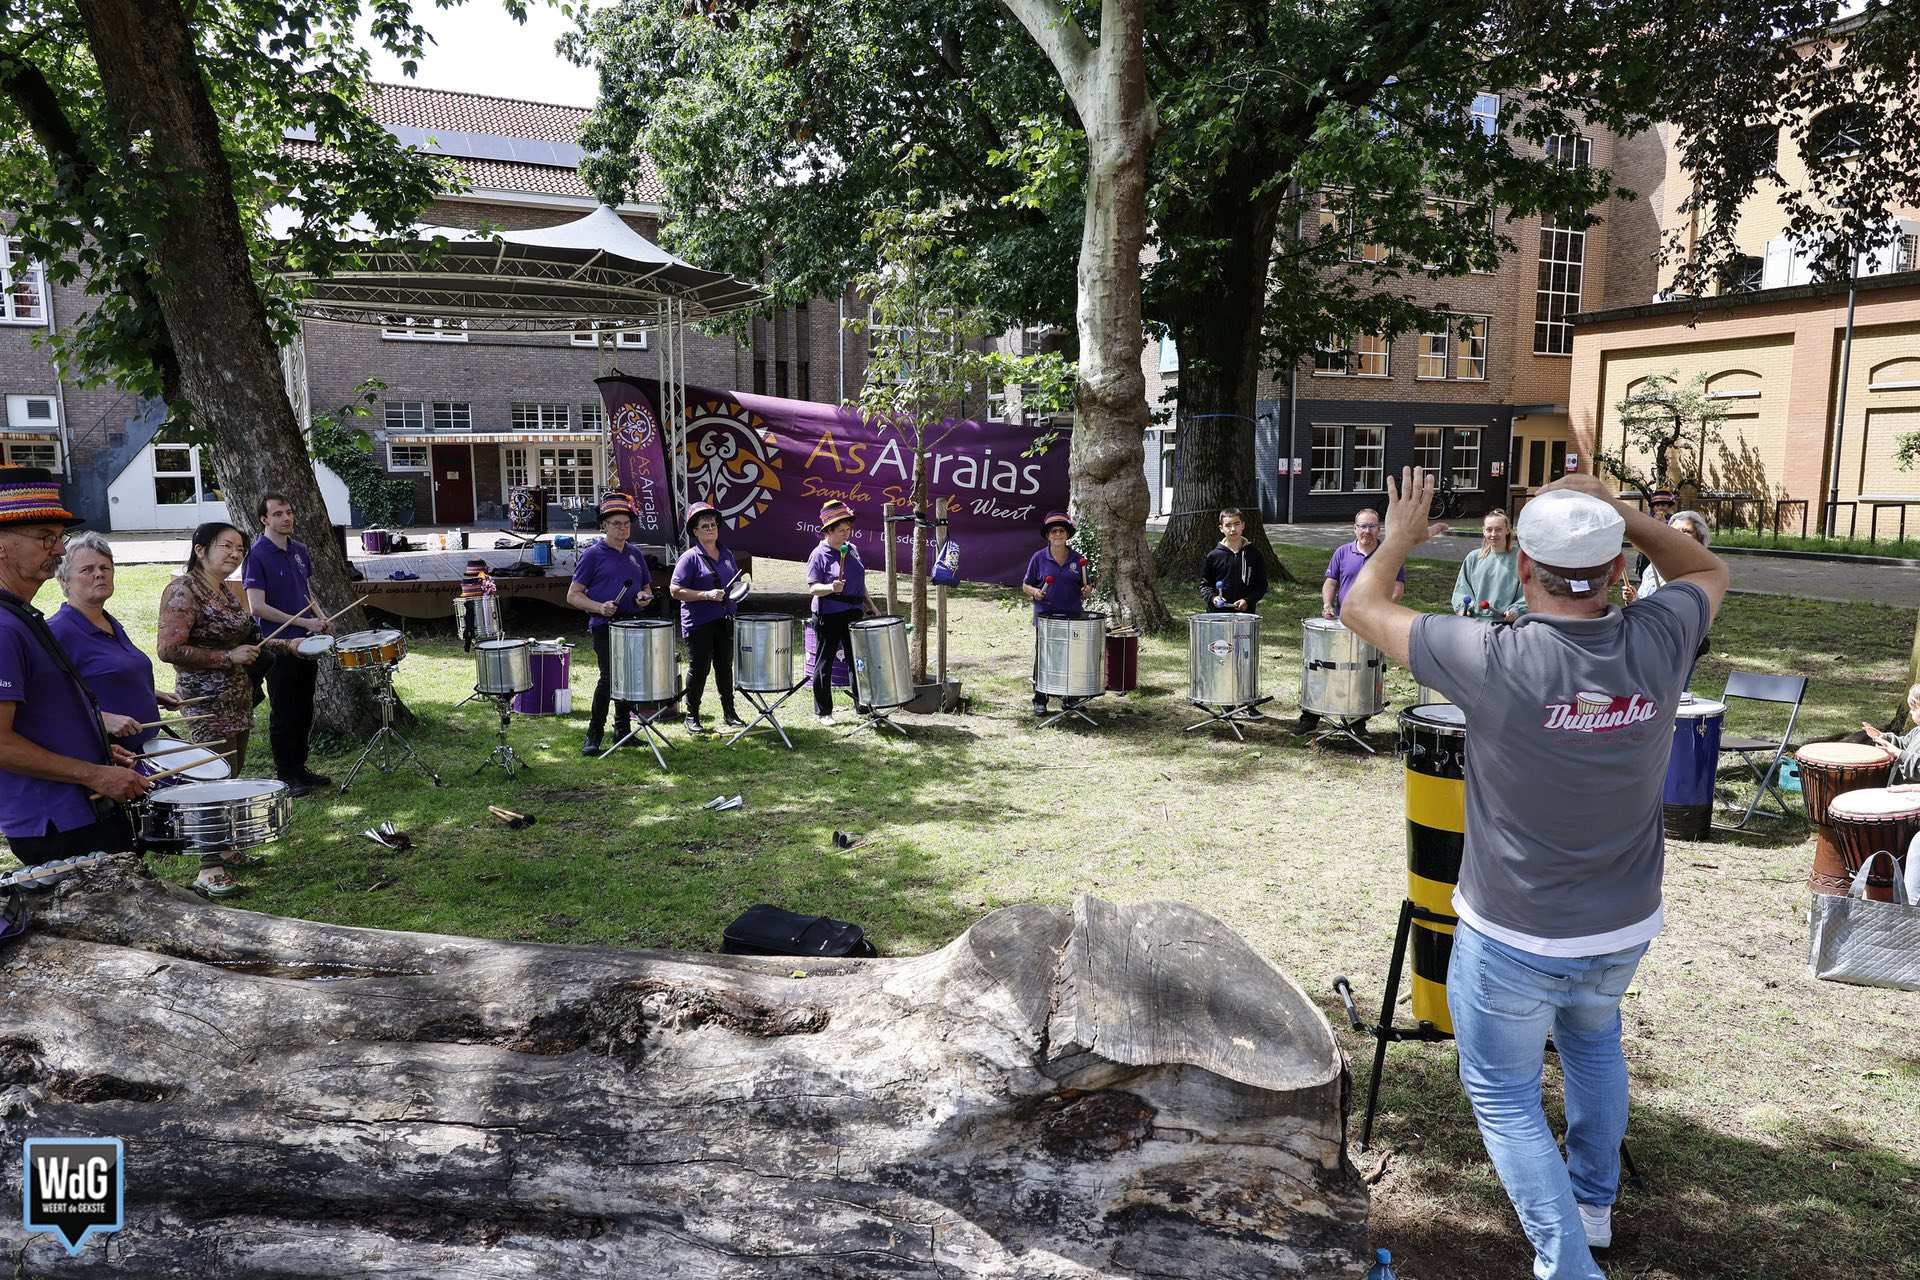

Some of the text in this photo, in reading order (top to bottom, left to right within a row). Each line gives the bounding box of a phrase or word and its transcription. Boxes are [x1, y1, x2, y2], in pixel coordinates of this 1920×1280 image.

[801, 476, 872, 502] Samba
[970, 498, 1036, 521] Weert
[796, 521, 822, 533] Sinc
[1543, 693, 1657, 733] Dununba
